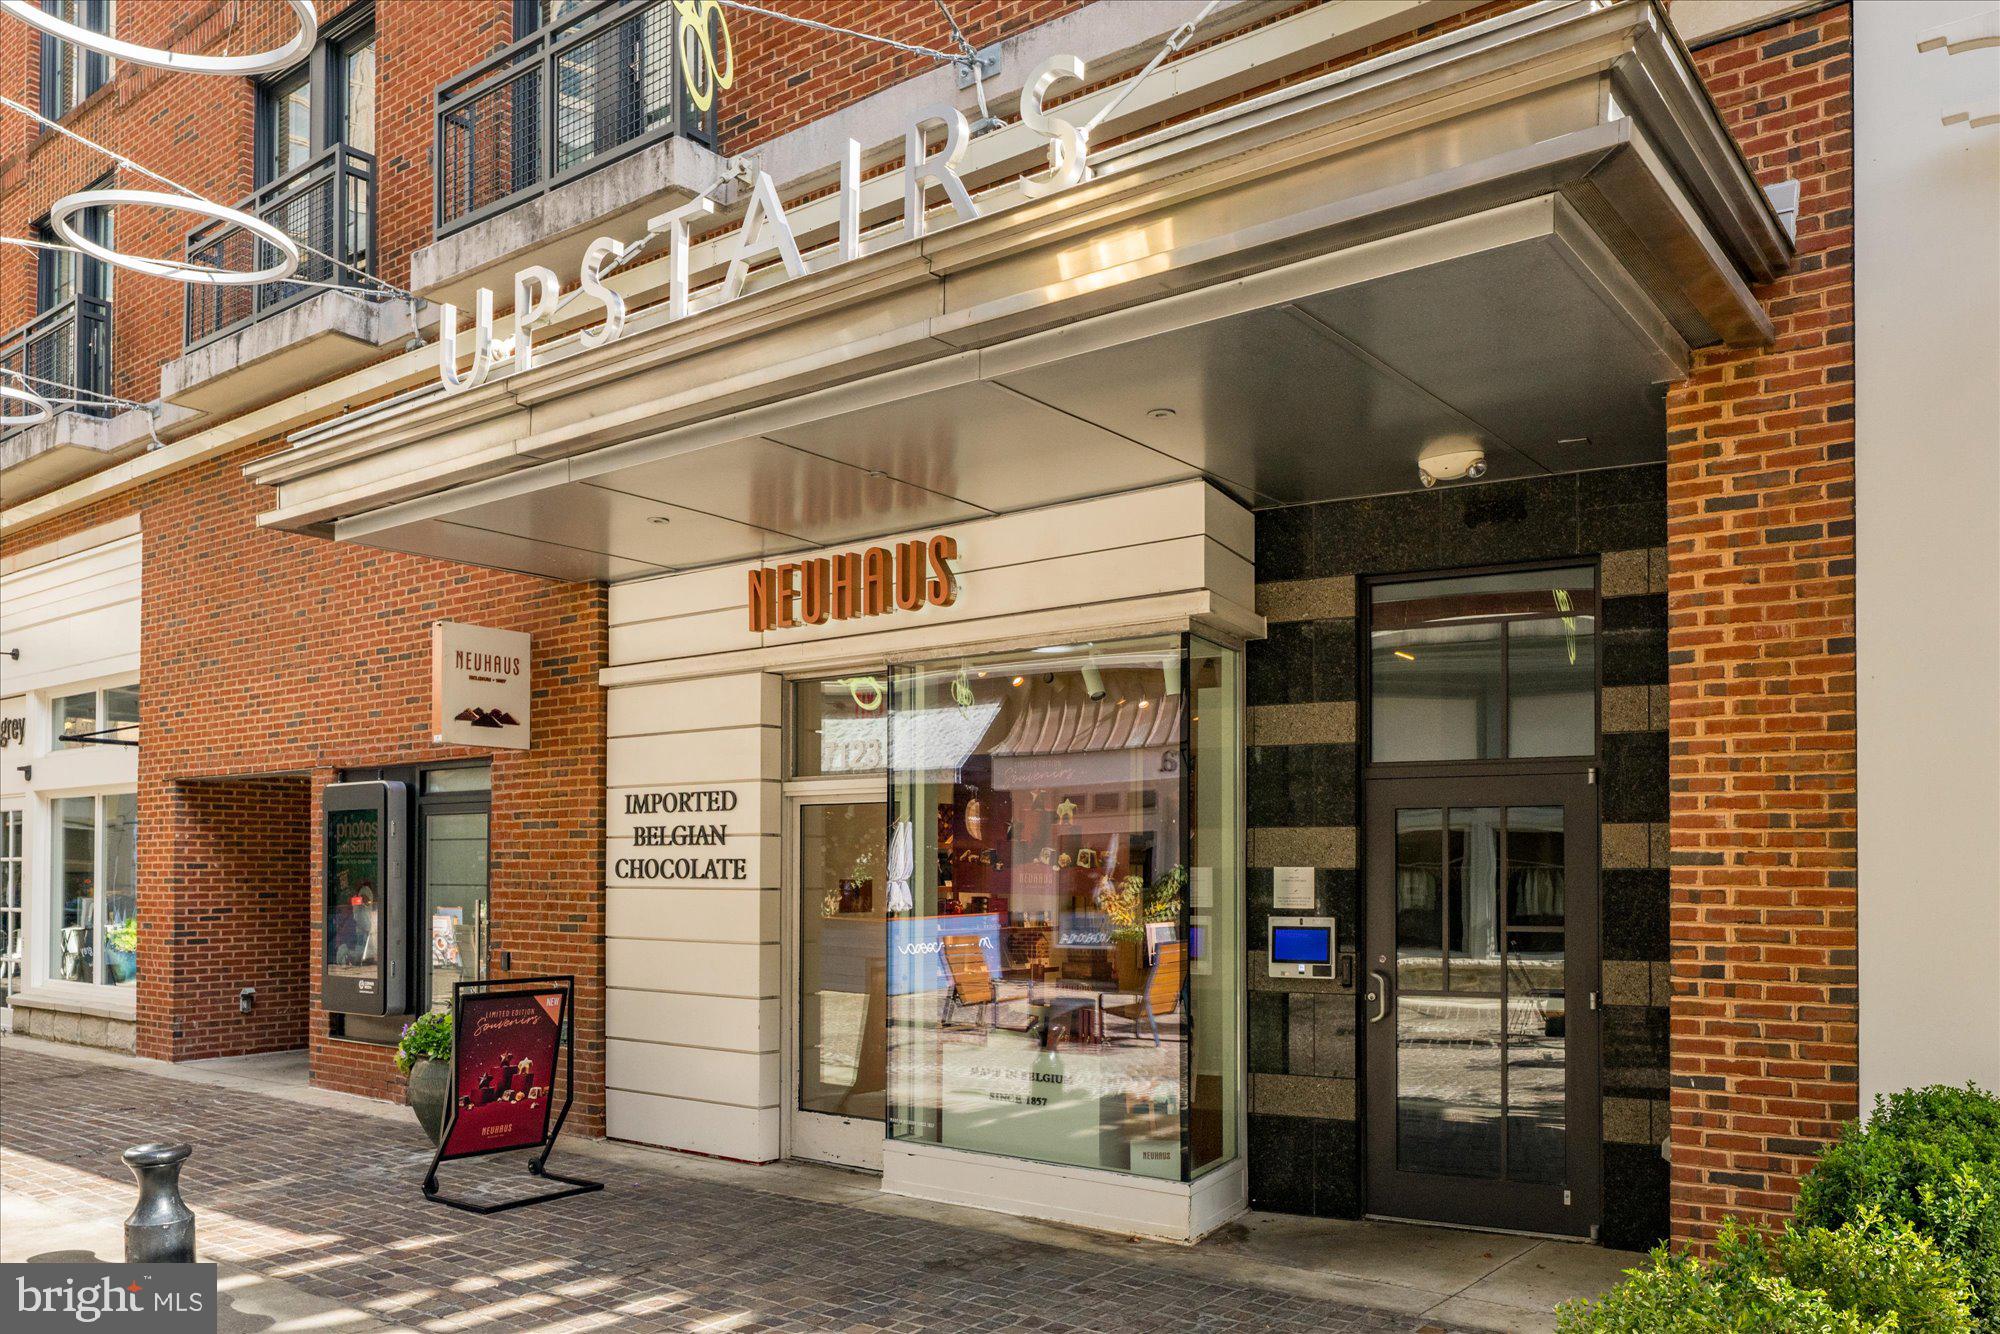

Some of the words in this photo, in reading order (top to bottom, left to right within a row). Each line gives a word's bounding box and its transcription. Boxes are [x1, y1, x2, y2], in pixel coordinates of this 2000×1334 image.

[439, 54, 1087, 396] UPSTAIRS
[748, 535, 957, 632] NEUHAUS
[456, 650, 520, 676] NEUHAUS
[0, 717, 26, 747] grey
[625, 790, 737, 814] IMPORTED
[336, 816, 378, 843] photos
[633, 824, 727, 846] BELGIAN
[615, 858, 746, 880] CHOCOLATE
[546, 998, 560, 1006] NEW
[485, 1010, 510, 1019] LIMITED
[511, 1008, 536, 1017] EDITION
[1026, 1097, 1048, 1106] 1857
[481, 1123, 513, 1136] NEUHAUS
[1142, 1151, 1171, 1160] NEUHAUS
